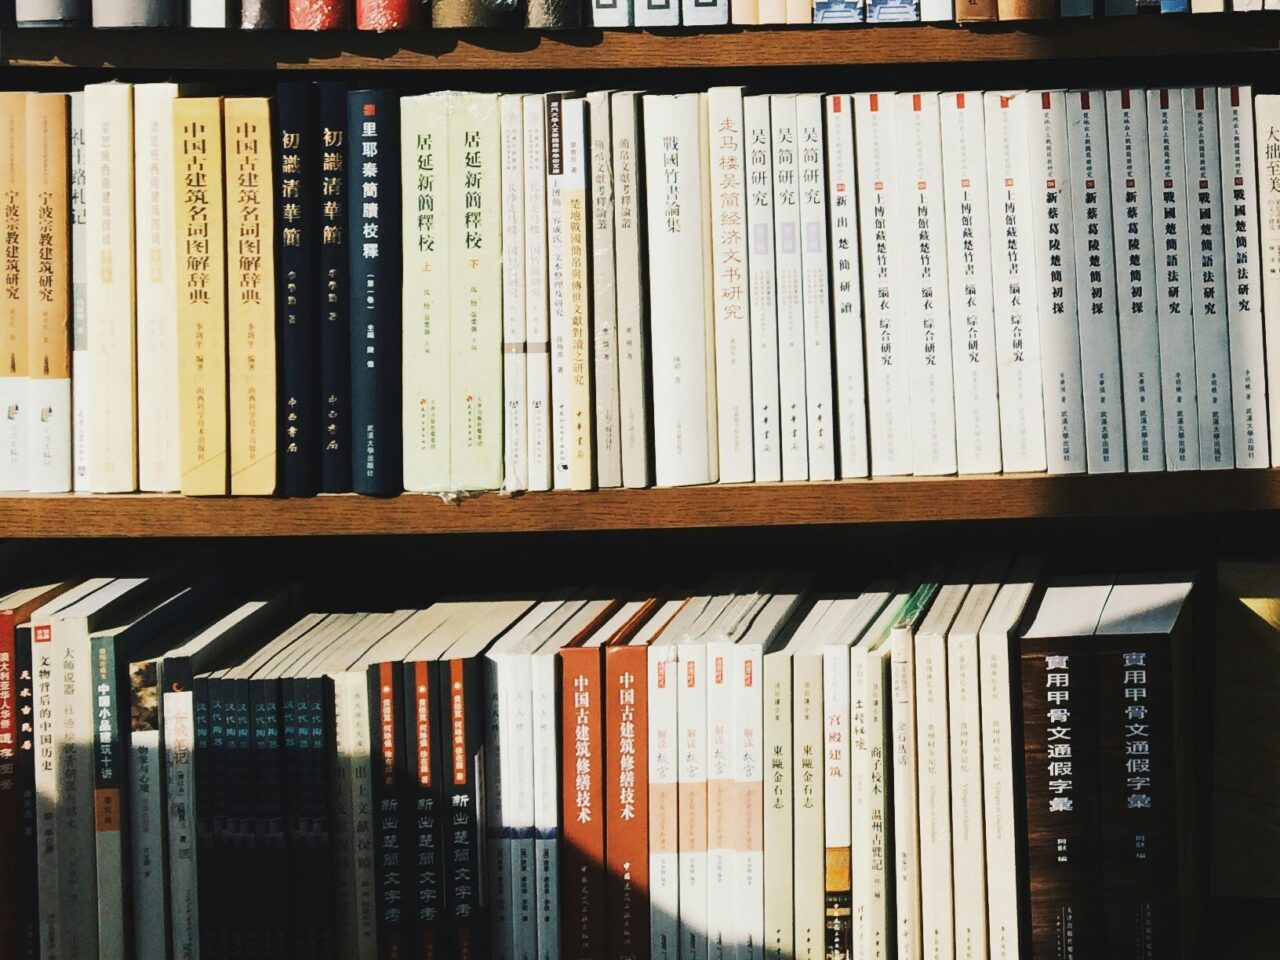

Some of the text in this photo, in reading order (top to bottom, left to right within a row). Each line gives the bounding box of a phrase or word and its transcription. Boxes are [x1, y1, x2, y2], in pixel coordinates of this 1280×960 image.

[184, 122, 210, 305] 中国古建筑名词图解辞典
[236, 122, 262, 304] 中国古建筑名词图解辞典
[282, 129, 301, 247] 初識清華簡
[322, 127, 343, 246] 初識清華簡
[362, 122, 379, 259] 里耶秦簡牘校釋
[417, 134, 434, 252] 居延新簡釋校
[464, 131, 483, 250] 居延新簡釋校
[663, 136, 681, 234] 戰國竹書論集
[717, 117, 744, 321] 走马楼吴简经济文书研究
[751, 128, 769, 207] 吴简研究
[777, 127, 796, 206] 吴简研究
[803, 126, 821, 206] 吴简研究
[1265, 125, 1280, 193] 大拙至美
[5, 190, 20, 299] 宁波宗教建筑研究
[38, 191, 53, 301] 宁波宗教建筑研究
[469, 259, 479, 270] 下
[1046, 191, 1064, 314] 新蔡葛陵楚簡初探
[1085, 191, 1104, 314] 新蔡葛陵楚簡初探
[1125, 191, 1144, 313] 新蔡葛陵楚簡初探
[1163, 191, 1181, 314] 戰國楚簡語法研究
[1198, 191, 1216, 314] 戰國楚簡語法研究
[1233, 189, 1250, 312] 戰國楚簡語法研究
[39, 655, 53, 771] 文物背后的中国历史
[574, 675, 591, 824] 中国古建筑修缮技术
[619, 672, 635, 821] 中国古建筑修缮技术
[828, 715, 843, 778] 宫殿建筑
[1045, 655, 1073, 812] 實用甲骨文通假字彙
[1123, 652, 1151, 809] 實用甲骨文通假字彙
[452, 794, 471, 917] 新出楚簡文字考
